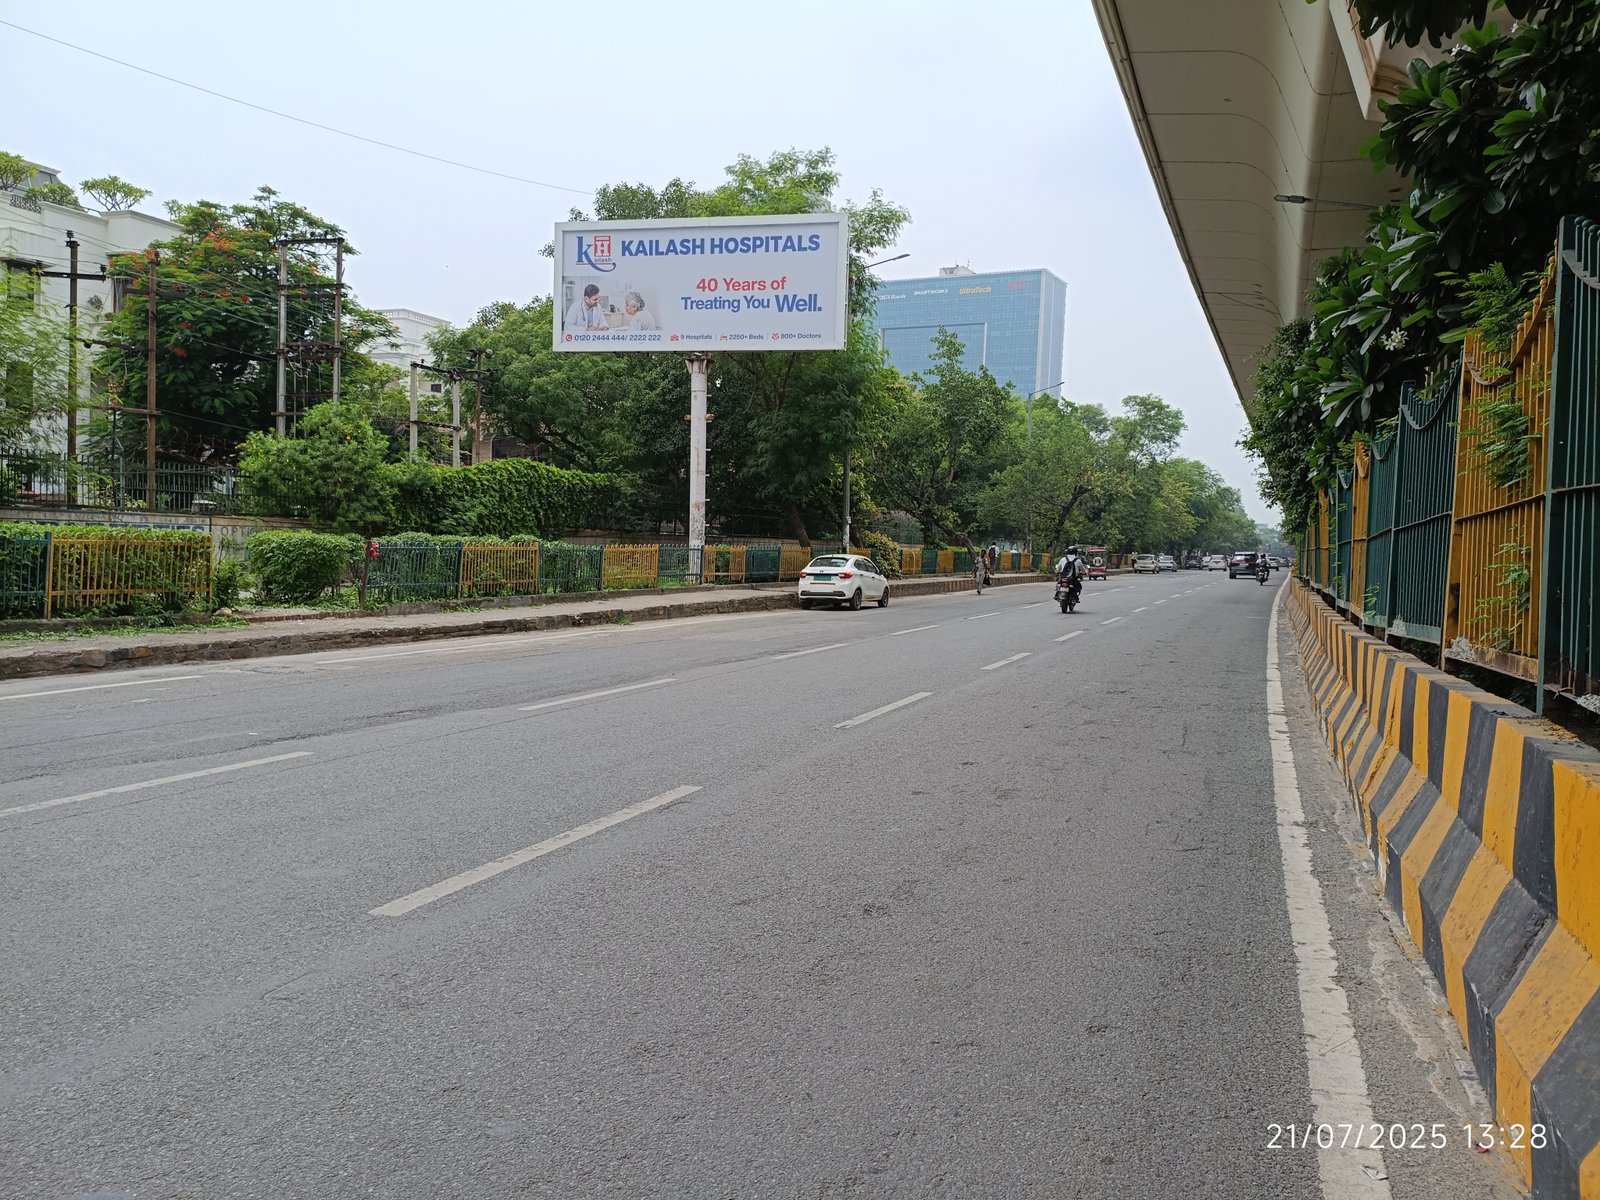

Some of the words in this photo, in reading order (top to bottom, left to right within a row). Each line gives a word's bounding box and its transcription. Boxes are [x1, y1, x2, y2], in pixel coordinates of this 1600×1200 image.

[621, 239, 705, 256] KAILASH
[710, 234, 821, 255] HOSPITALS
[696, 277, 719, 292] 40
[723, 276, 767, 292] Years
[770, 276, 787, 291] of
[681, 296, 741, 313] Treating
[743, 295, 771, 309] You
[775, 293, 822, 313] Well.
[685, 333, 713, 342] Hospitals
[728, 333, 748, 341] 2250+
[797, 332, 822, 340] Doctors
